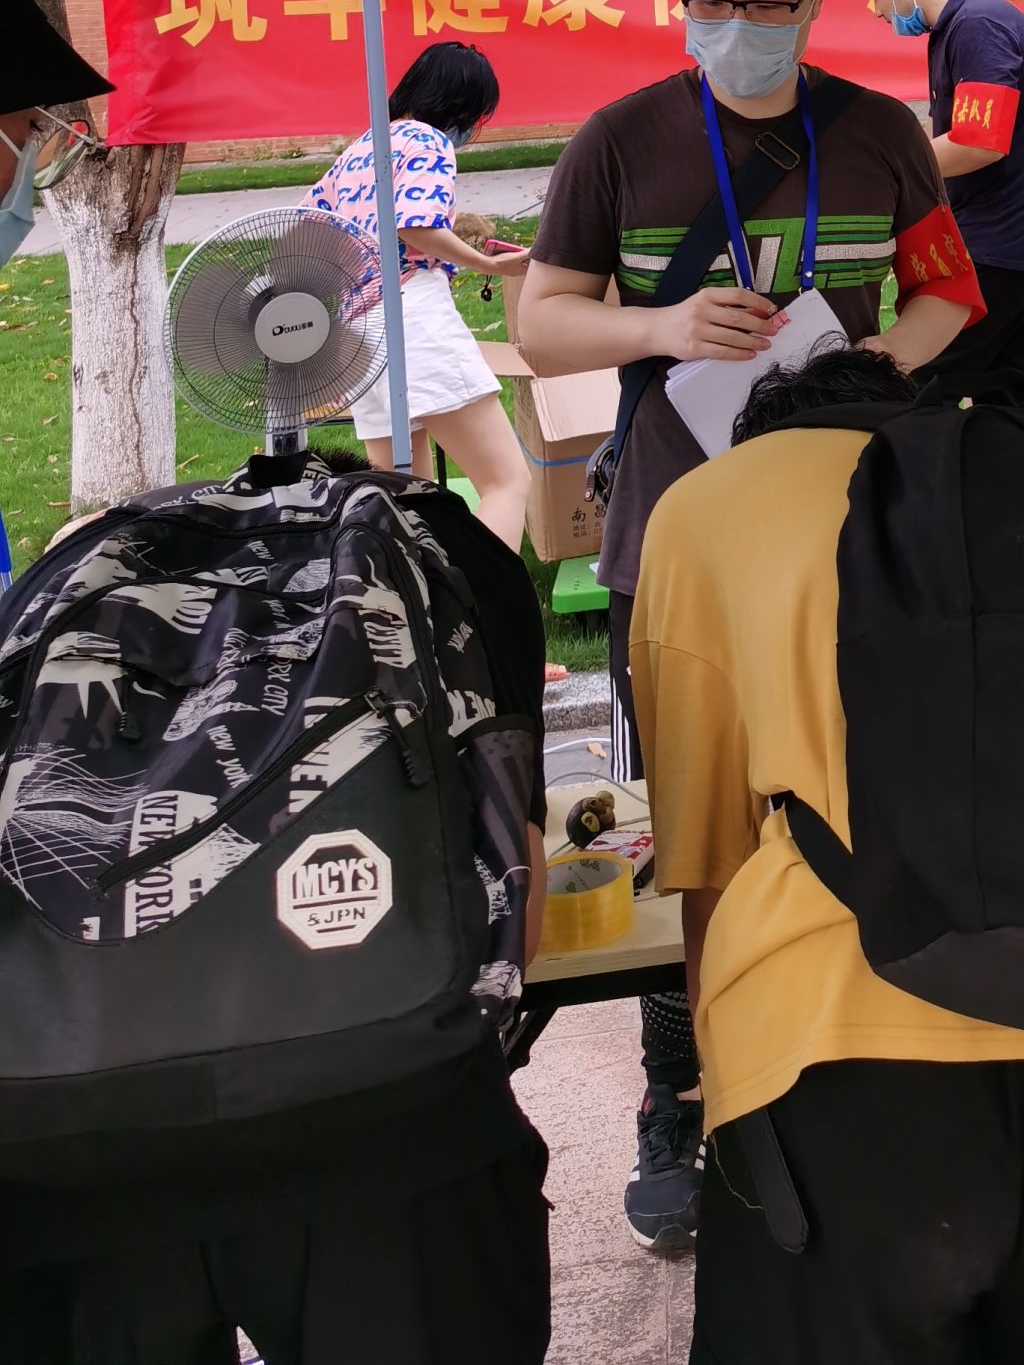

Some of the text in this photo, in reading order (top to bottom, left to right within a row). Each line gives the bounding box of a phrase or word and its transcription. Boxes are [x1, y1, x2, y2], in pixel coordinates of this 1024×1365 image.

[909, 233, 972, 283] 党员突
[206, 724, 237, 751] new
[134, 861, 175, 935] ORK
